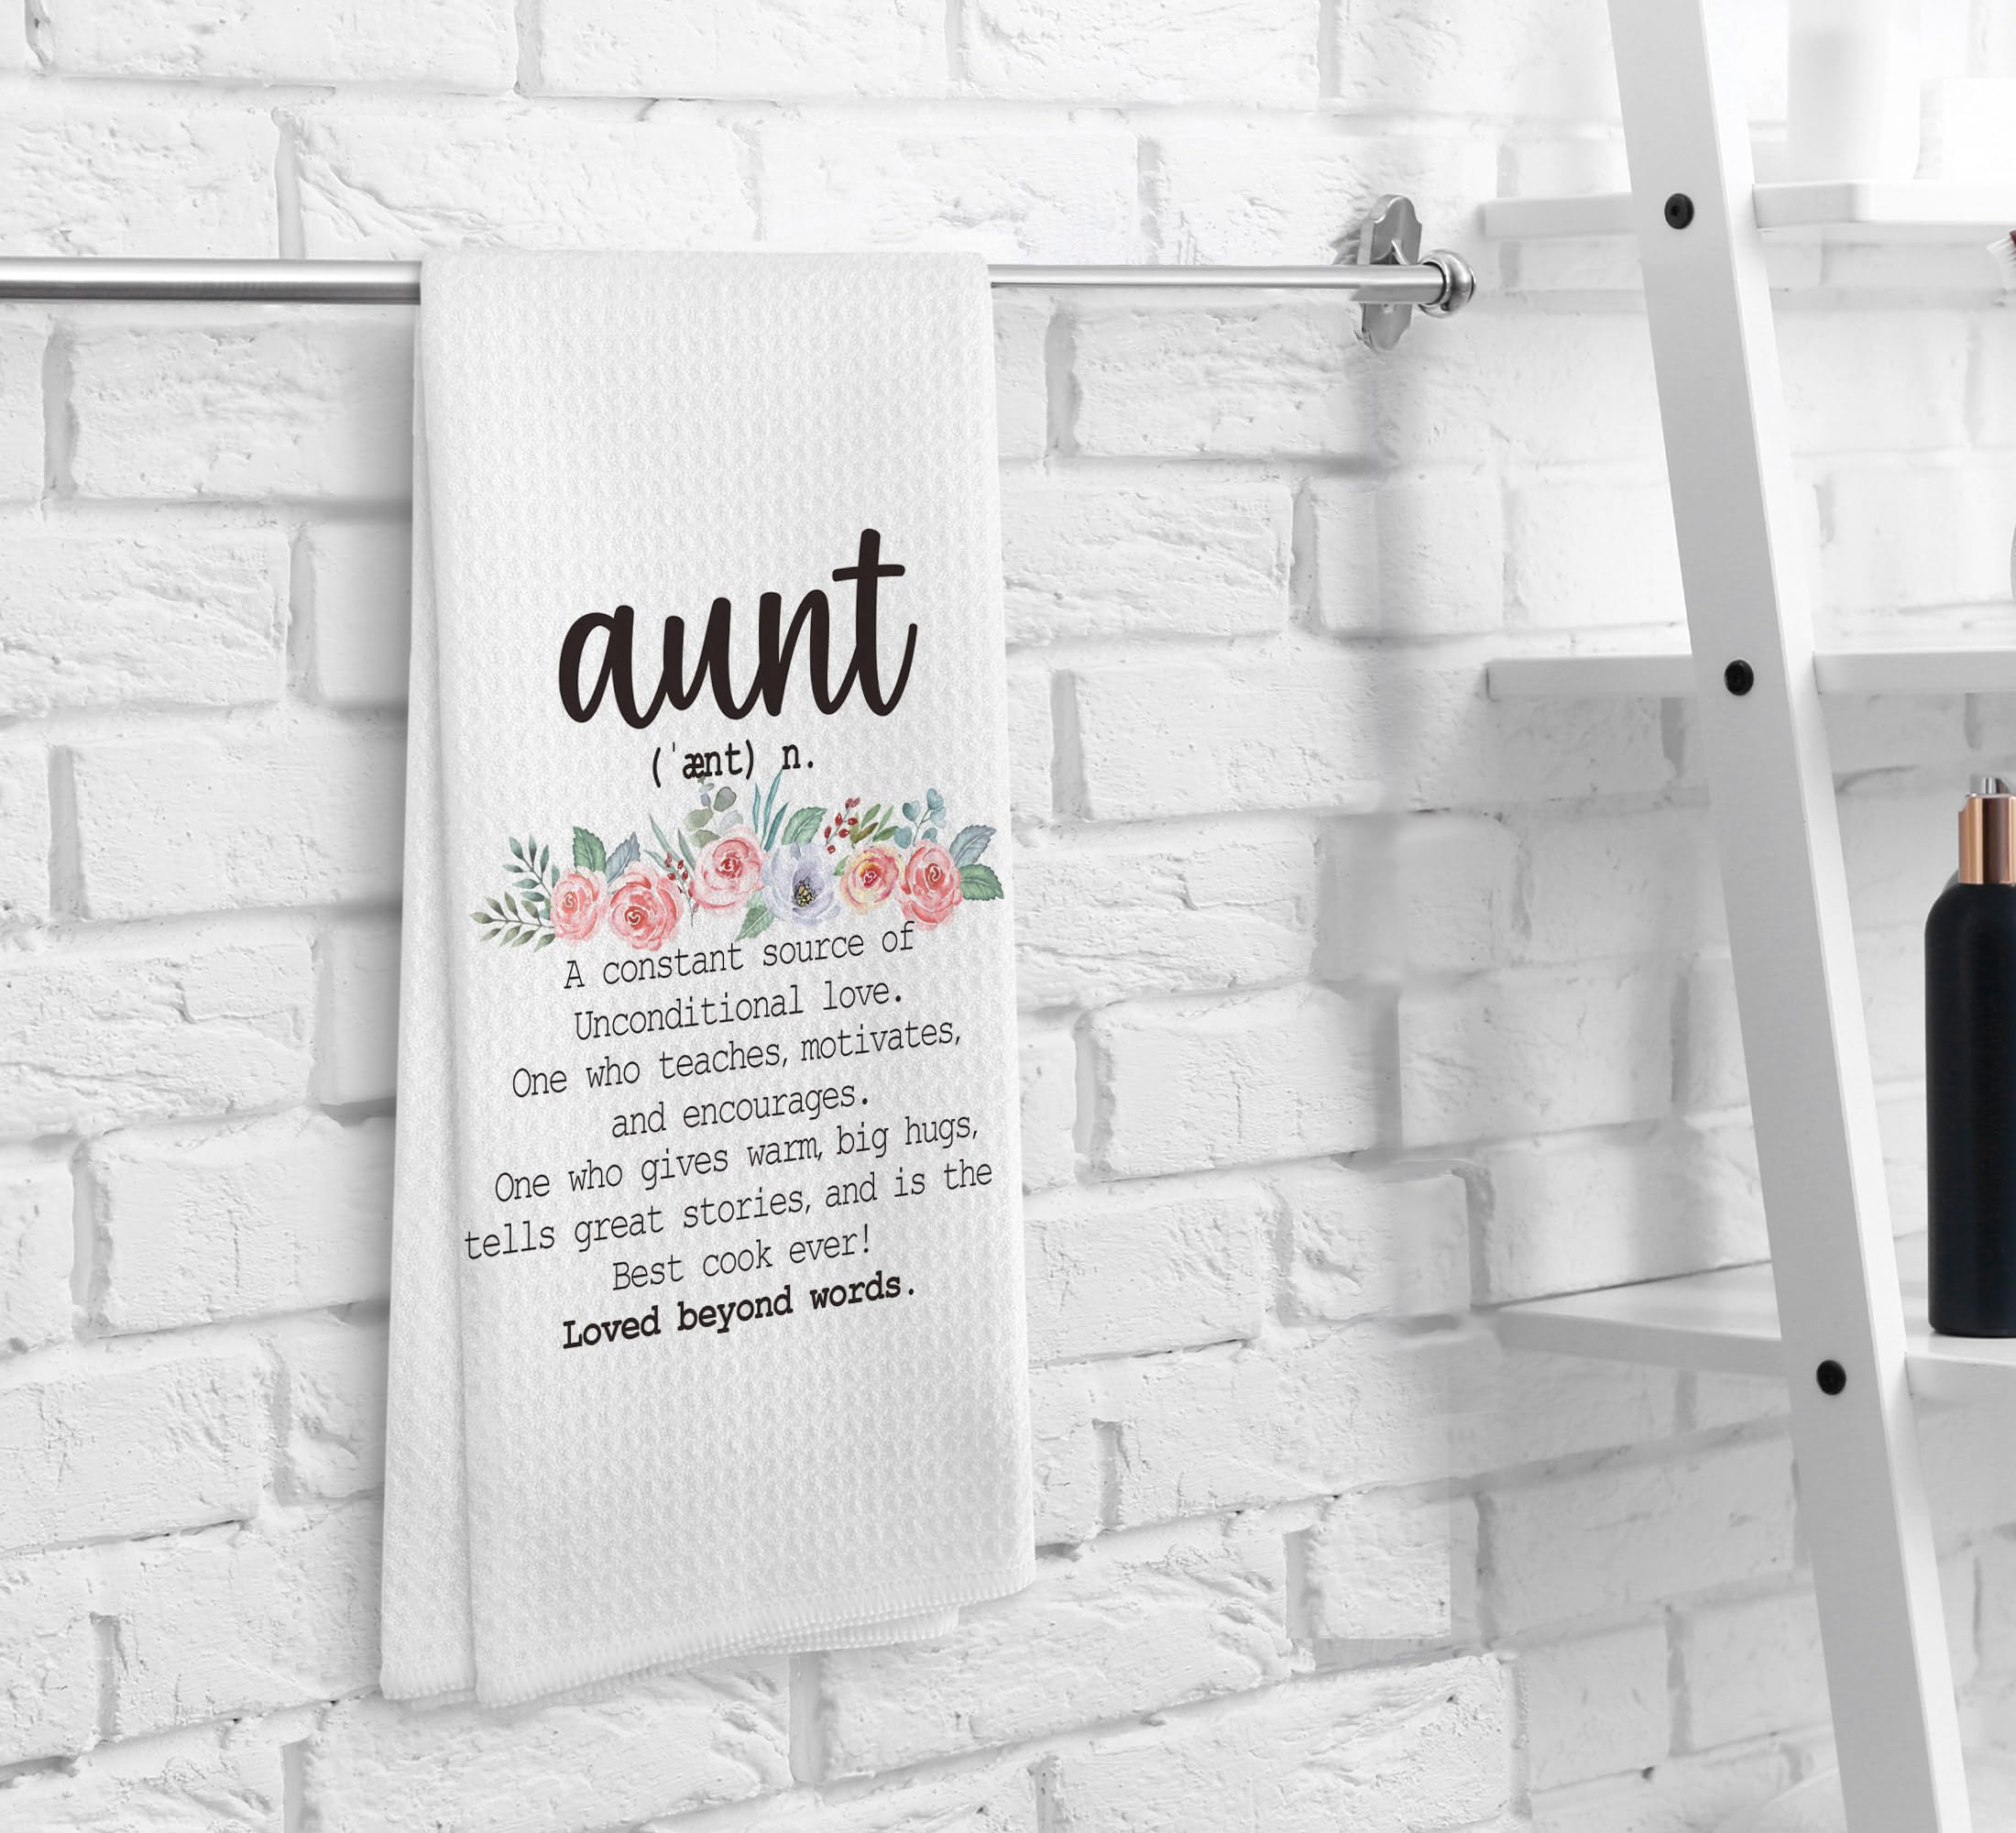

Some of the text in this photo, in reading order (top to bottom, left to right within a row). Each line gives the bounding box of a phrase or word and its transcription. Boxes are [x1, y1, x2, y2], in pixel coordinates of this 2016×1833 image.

[558, 528, 918, 730] aunt
[780, 743, 814, 772] n.
[564, 920, 915, 990] A constant source of
[574, 980, 902, 1041] Unconditional love.
[512, 1020, 960, 1098] One who teaches, motivates,
[611, 1084, 868, 1138] and encourages.
[495, 1115, 978, 1202] One who gives warm, big hugs,
[464, 1158, 992, 1260] tells great stories, and is the
[612, 1223, 869, 1291] Best cook ever!
[563, 1269, 915, 1350] Loved beyond words.
